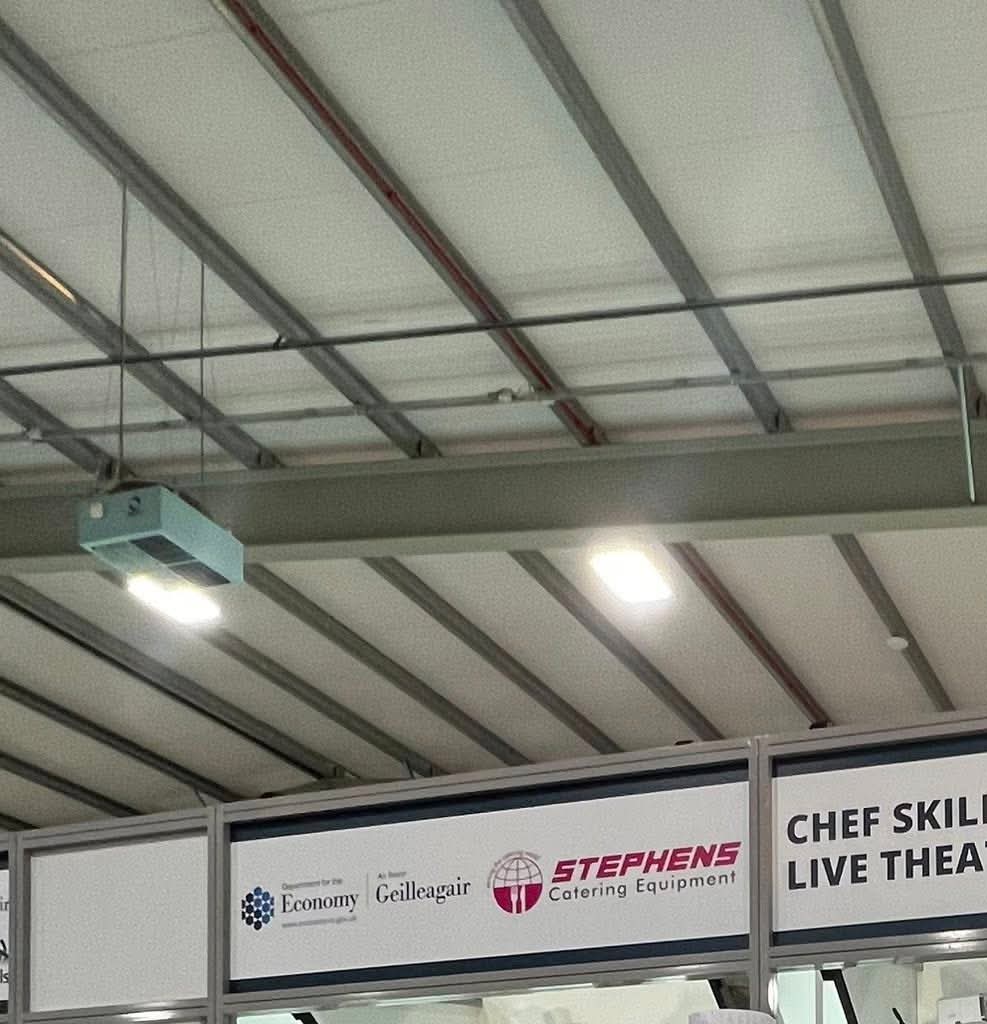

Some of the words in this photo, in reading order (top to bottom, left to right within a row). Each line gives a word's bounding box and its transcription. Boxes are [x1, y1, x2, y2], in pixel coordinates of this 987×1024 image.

[787, 806, 880, 845] CHEF
[551, 841, 743, 883] STEPHENS
[788, 853, 868, 890] LIVE
[281, 893, 359, 913] Economy
[376, 876, 471, 904] Geilleagair
[549, 881, 627, 902] Catering
[636, 870, 737, 895] Equipment
